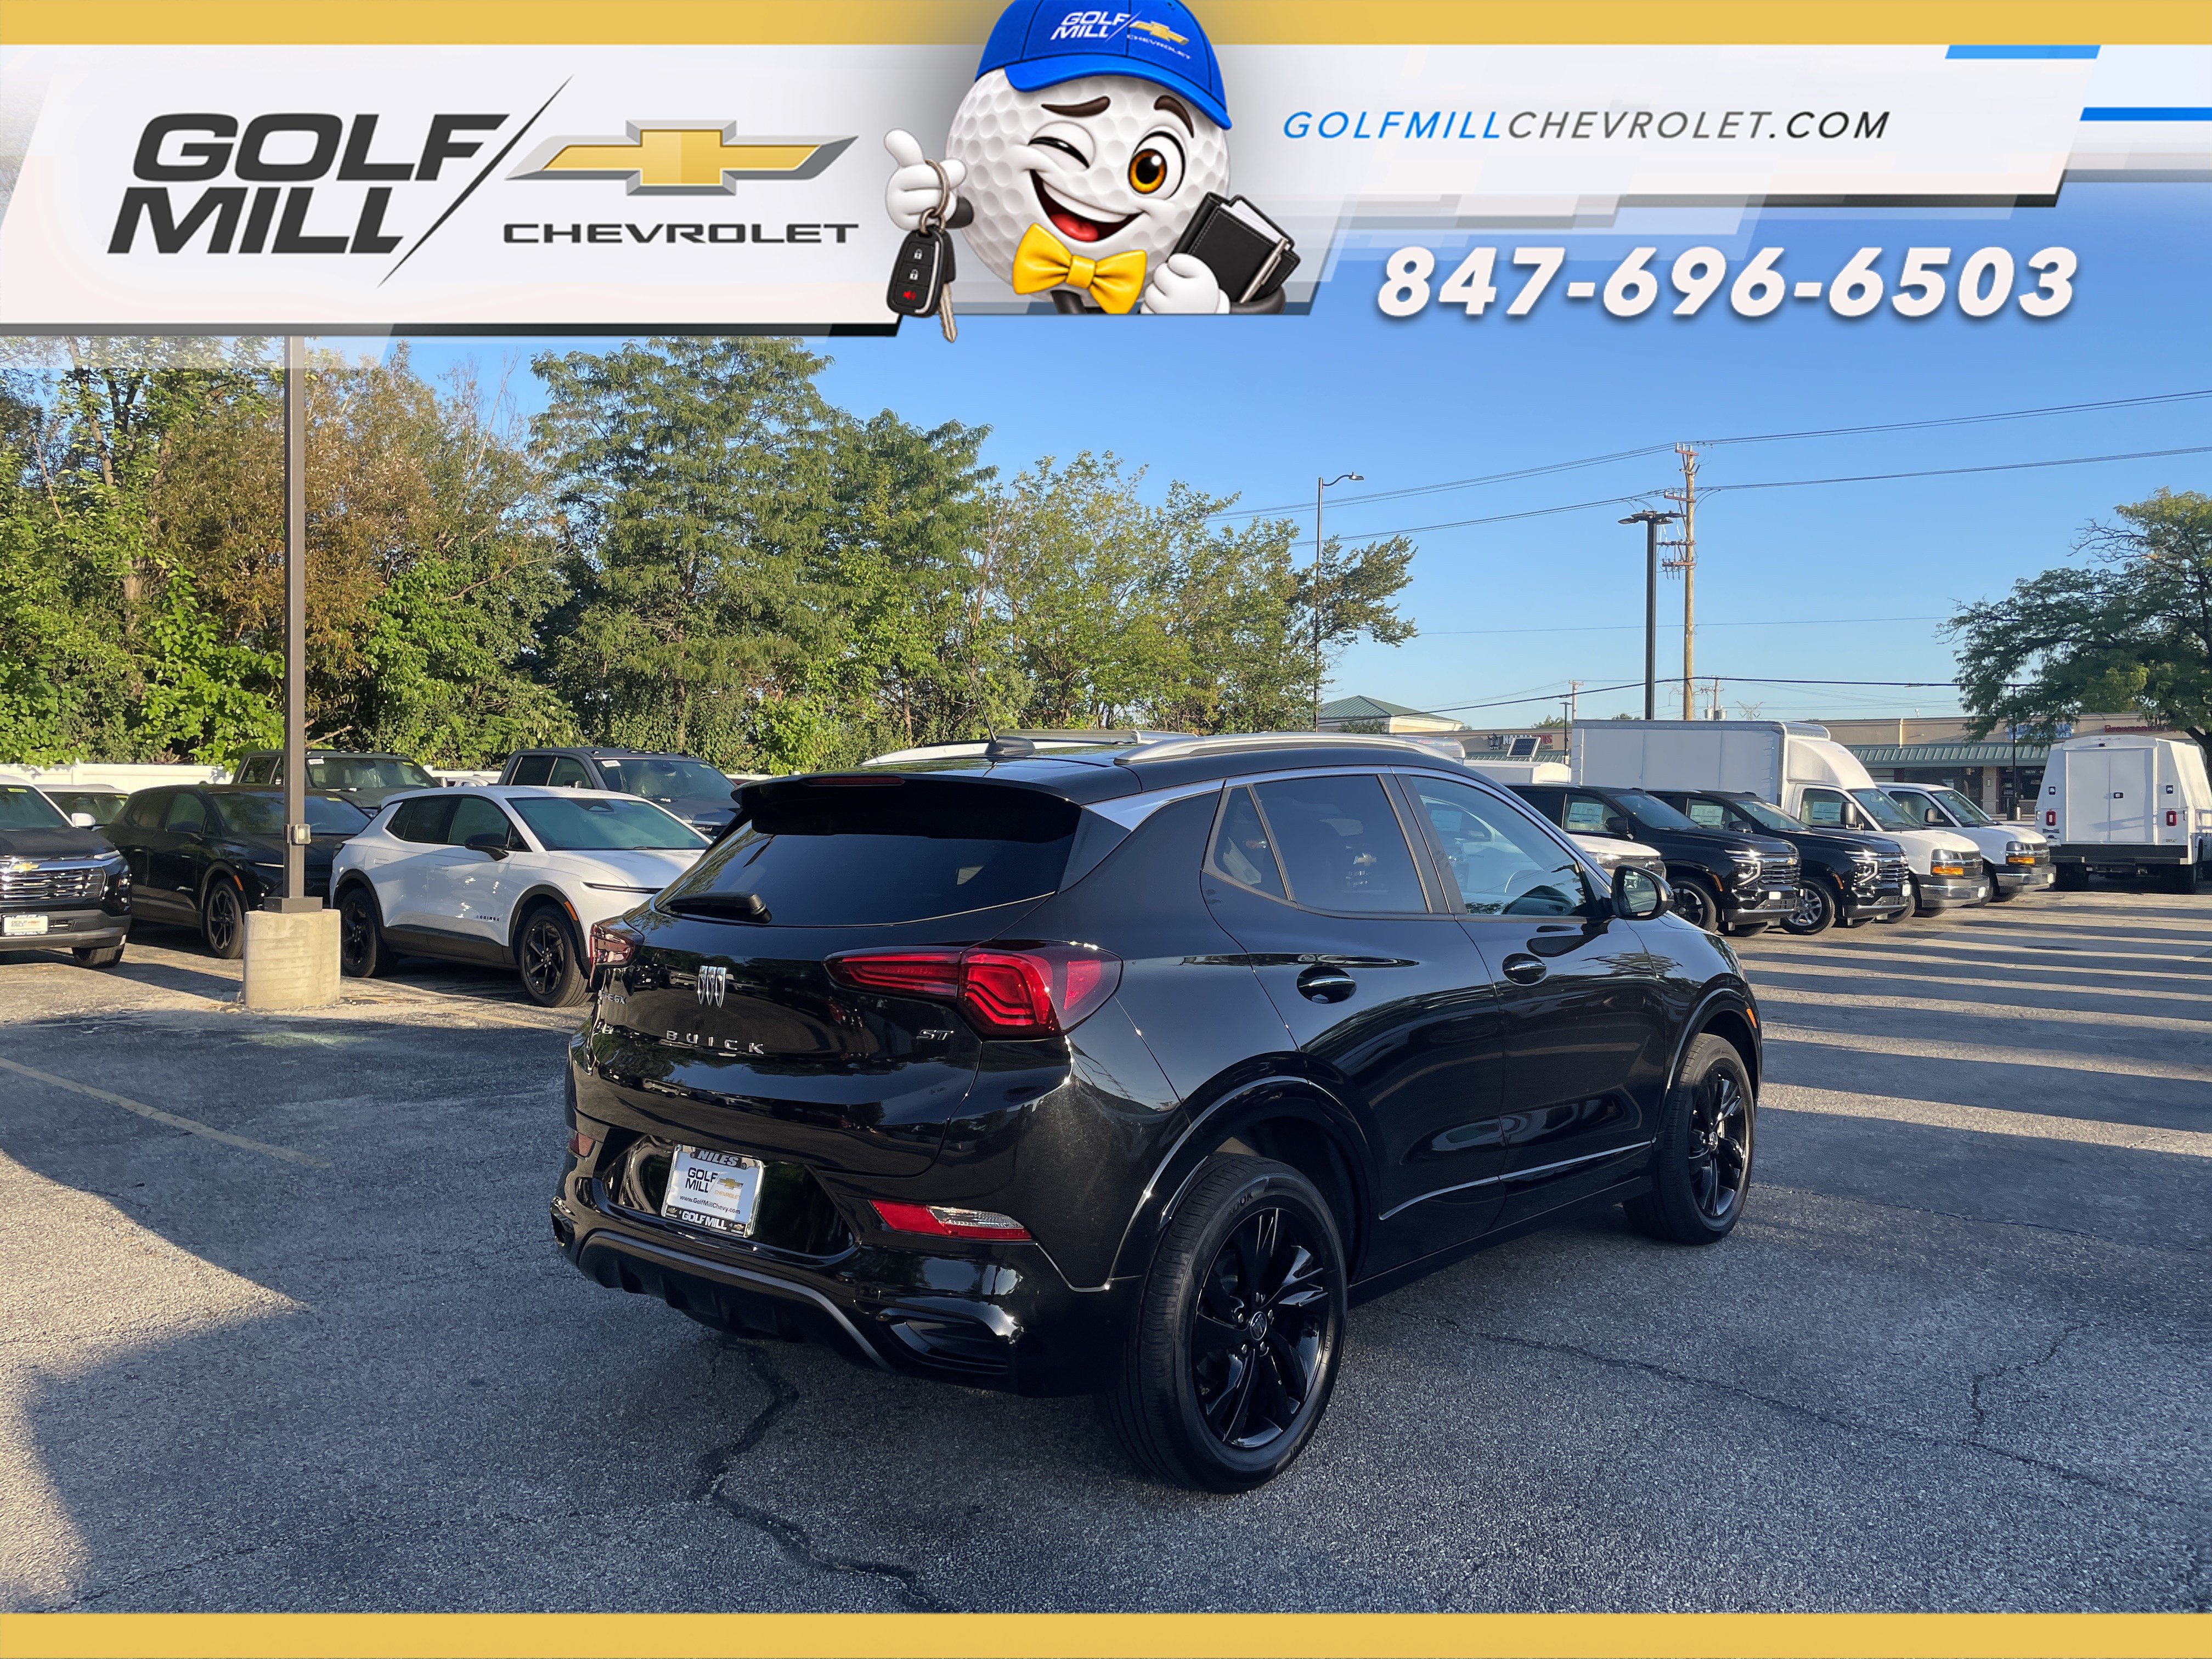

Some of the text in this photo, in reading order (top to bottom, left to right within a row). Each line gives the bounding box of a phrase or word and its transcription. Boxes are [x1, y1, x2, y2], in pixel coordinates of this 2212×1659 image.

[666, 1030, 764, 1054] BUICK
[916, 1029, 954, 1040] ST
[697, 1150, 739, 1166] NILES
[687, 1167, 719, 1183] GOLF
[685, 1178, 708, 1193] MILL
[680, 1195, 741, 1215] www.GolfMillChevy.com
[681, 1210, 706, 1224] GOLF
[704, 1216, 727, 1231] MILL
